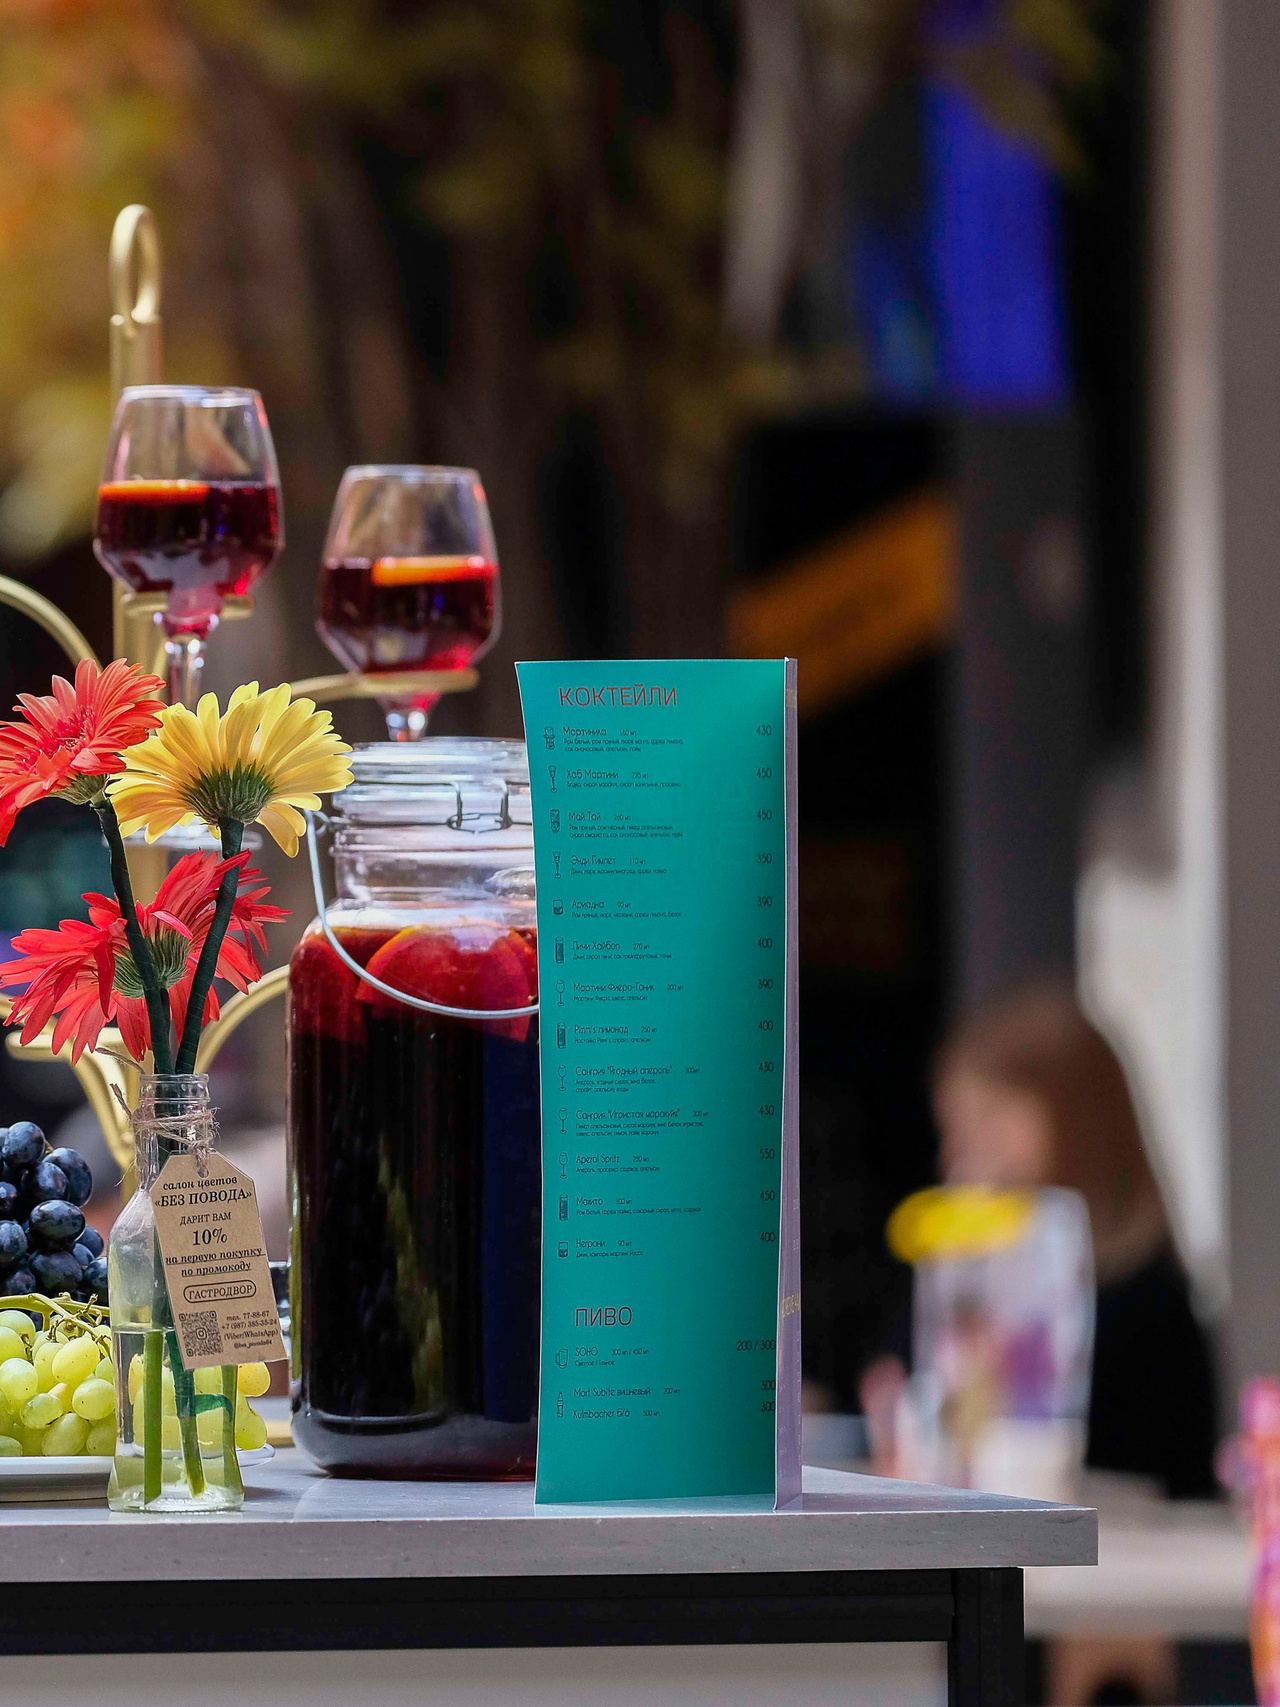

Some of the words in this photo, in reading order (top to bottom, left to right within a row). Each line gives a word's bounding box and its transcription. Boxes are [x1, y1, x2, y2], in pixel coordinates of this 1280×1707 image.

[559, 683, 676, 706] КОКТЕЙЛИ
[563, 726, 606, 738] Мартиника
[756, 725, 771, 735] 430
[566, 768, 583, 779] Хаб
[584, 769, 619, 780] Мартини
[756, 767, 772, 777] 450
[568, 811, 586, 821] Май
[587, 811, 601, 821] Тай
[757, 809, 772, 820] 450
[757, 853, 772, 863] 350
[757, 896, 772, 907] 390
[572, 940, 591, 950] Личи
[592, 940, 620, 951] Хайбол
[758, 938, 773, 948] 400
[573, 982, 606, 994] Мартини
[758, 979, 773, 989] 390
[574, 1024, 596, 1034] Pimm's
[598, 1026, 629, 1035] лимонад
[758, 1020, 773, 1030] 400
[575, 1066, 606, 1077] Сангрия
[758, 1062, 774, 1072] 430
[576, 1109, 606, 1121] Сангрия
[759, 1105, 774, 1115] 430
[576, 1154, 599, 1165] Aperol
[601, 1154, 620, 1165] Spritz
[759, 1149, 775, 1159] 550
[163, 1181, 194, 1190] салон
[197, 1176, 237, 1189] цветов
[155, 1194, 185, 1207] «БЕЗ
[188, 1188, 252, 1204] ПОВОДА»
[760, 1190, 775, 1200] 450
[576, 1197, 604, 1206] Мохито
[180, 1214, 210, 1226] ДАРИТ
[212, 1212, 231, 1222] ВАМ
[192, 1228, 228, 1246] 10%
[760, 1232, 775, 1242] 400
[576, 1240, 605, 1249] Негрони
[165, 1256, 178, 1264] на
[181, 1253, 217, 1264] первую
[220, 1247, 262, 1259] покупку
[181, 1268, 193, 1277] по
[196, 1261, 252, 1275] промокоду
[188, 1284, 253, 1300] ГАСТРОДВОР
[576, 1306, 632, 1326] ПИВО
[736, 1340, 751, 1351] 200
[760, 1340, 776, 1350] 300
[575, 1346, 599, 1357] SOHO
[760, 1380, 776, 1390] 300
[617, 1387, 651, 1396] вишневый
[760, 1401, 776, 1411] 300
[616, 1409, 630, 1418] б/а
